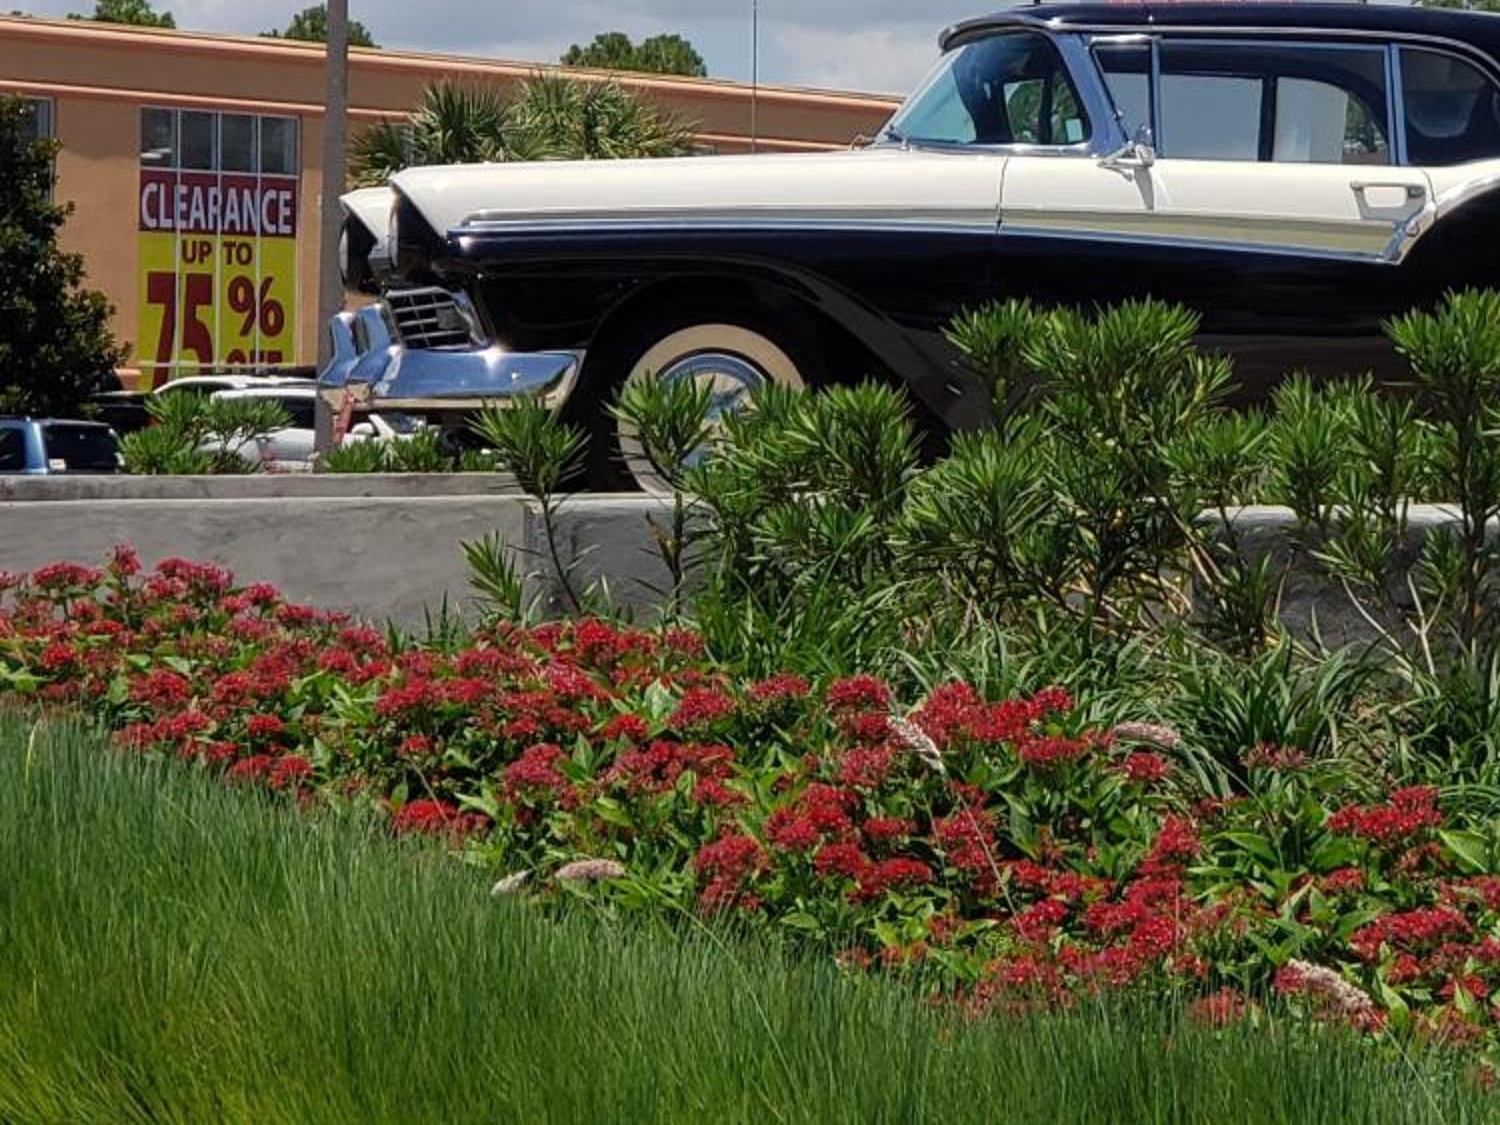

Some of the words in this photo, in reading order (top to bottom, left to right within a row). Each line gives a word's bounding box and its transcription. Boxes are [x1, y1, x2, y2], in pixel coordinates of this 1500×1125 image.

[141, 181, 293, 234] CLEARANCE
[180, 240, 212, 264] UP
[222, 242, 253, 265] TO
